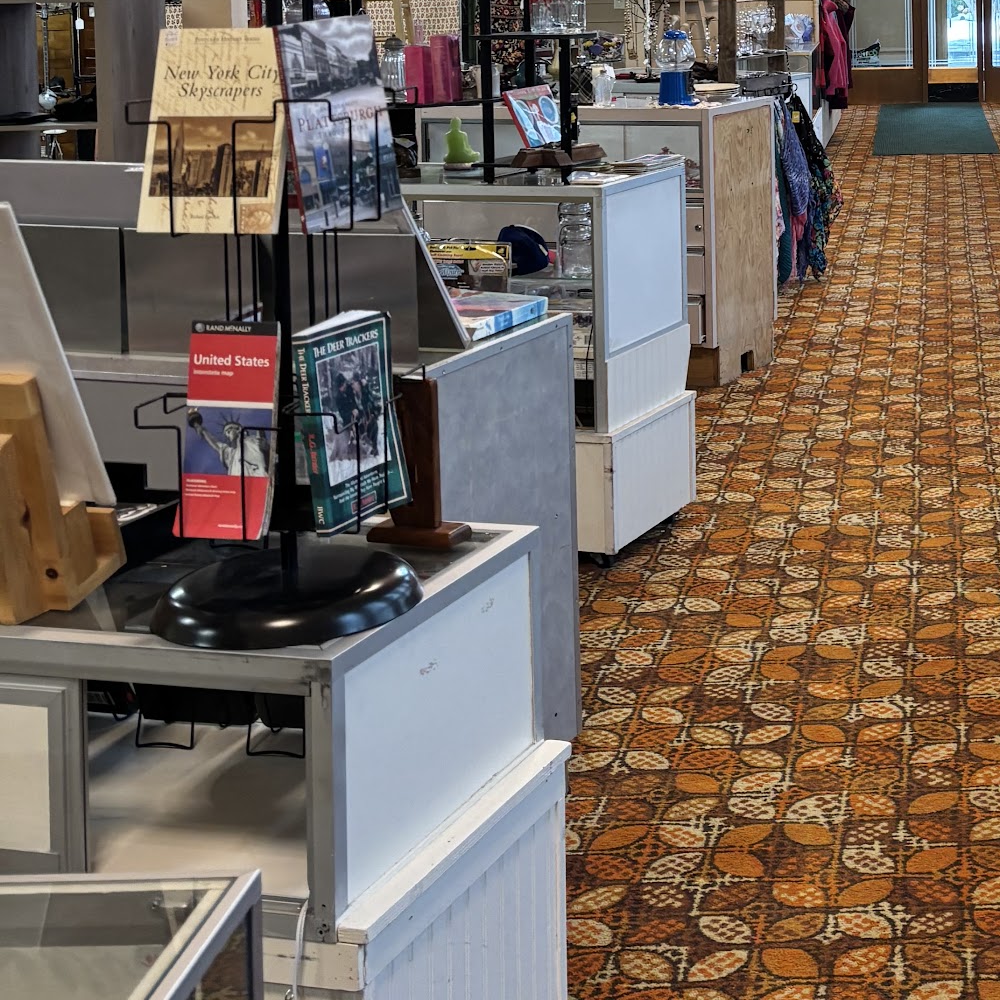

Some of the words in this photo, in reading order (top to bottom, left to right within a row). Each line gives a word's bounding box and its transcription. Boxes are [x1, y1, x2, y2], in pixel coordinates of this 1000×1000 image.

[163, 65, 200, 81] New
[206, 64, 240, 81] York
[247, 64, 280, 85] City
[177, 82, 265, 102] Skyscrapers
[313, 345, 326, 358] THE
[326, 339, 345, 356] DEER
[345, 329, 379, 348] TRACKERS
[193, 353, 232, 366] United
[234, 354, 270, 368] States
[299, 363, 308, 382] DEER
[301, 383, 311, 415] TRACKER
